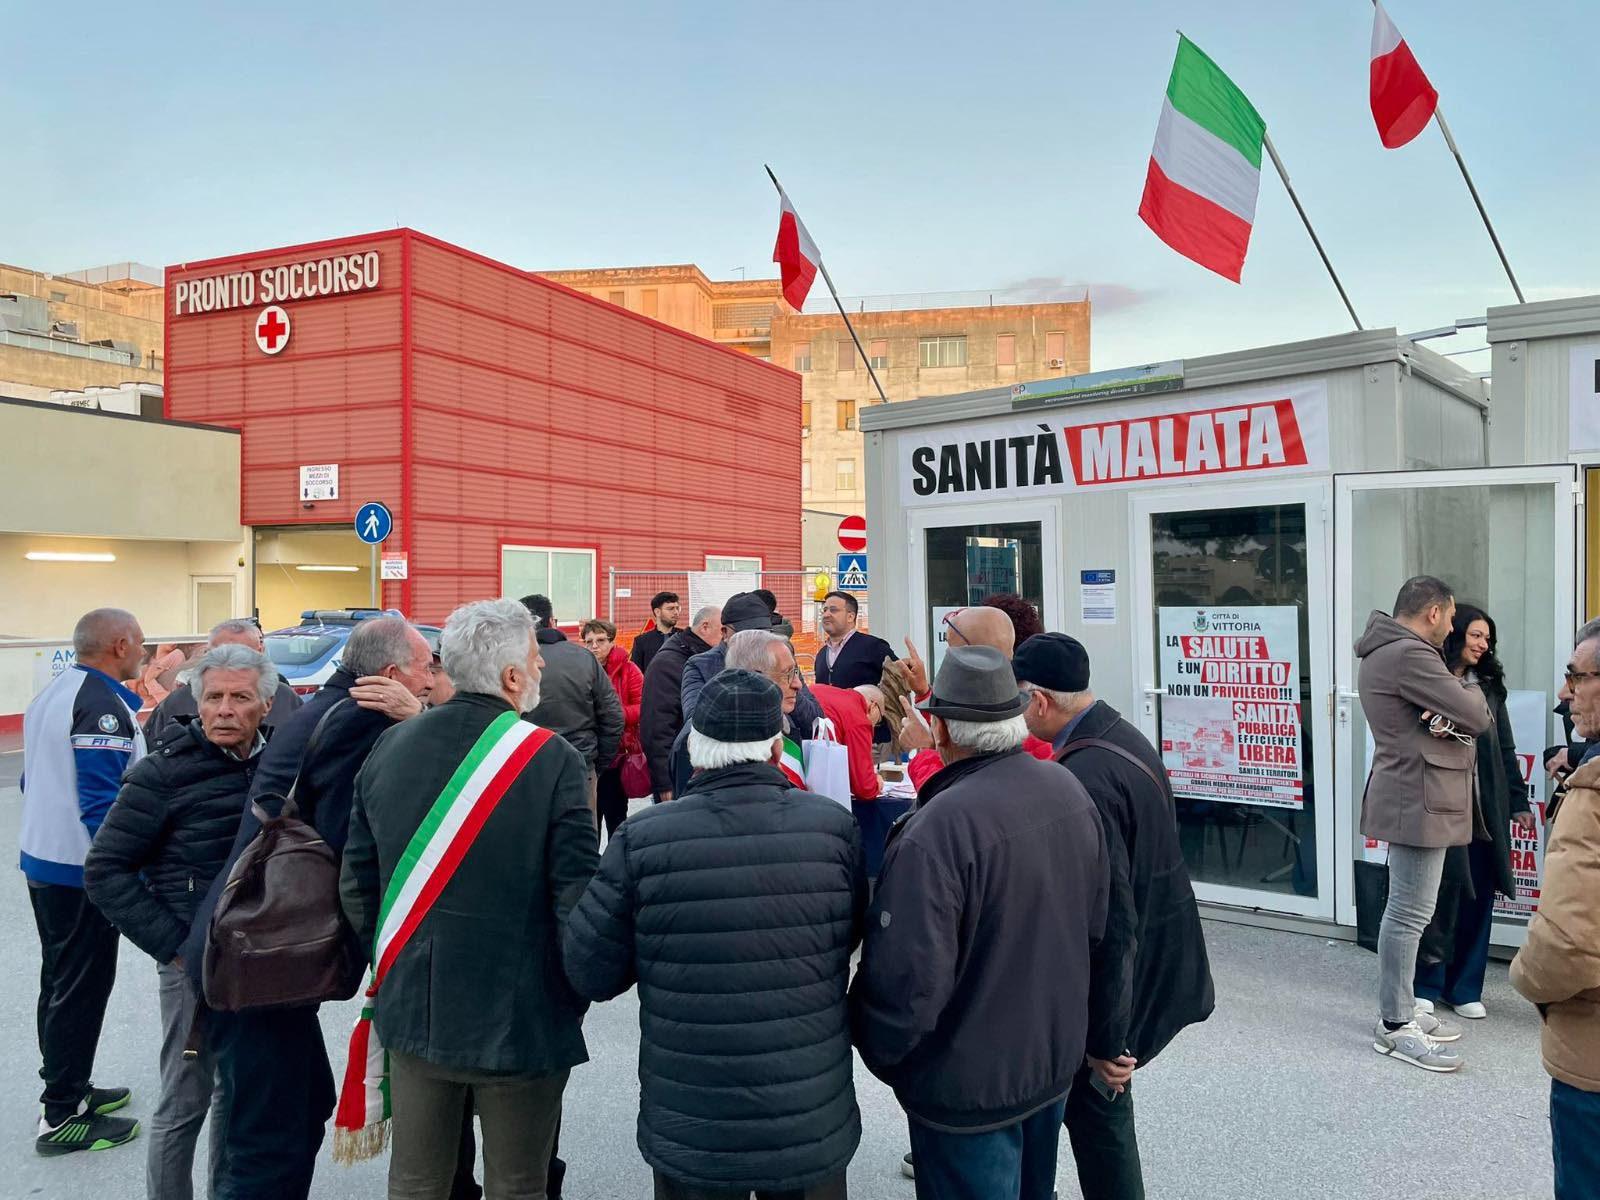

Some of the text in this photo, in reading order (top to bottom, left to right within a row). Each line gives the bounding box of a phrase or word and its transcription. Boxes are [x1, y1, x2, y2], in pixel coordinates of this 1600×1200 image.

[175, 251, 379, 315] PRONTO SOCCORSO
[911, 404, 1286, 496] SANITÀ MALATA
[1212, 622, 1261, 631] VITTORIA
[1166, 635, 1260, 659] LA SALUTE
[52, 650, 75, 662] AM
[1177, 660, 1286, 684] È UN DIRITTO
[1168, 684, 1293, 700] NON UN PRIVILEGIO!!!
[1234, 702, 1297, 724] SANITÀ
[1238, 722, 1297, 737] PUBBLICA
[1238, 734, 1297, 747] EFFICIENTE
[1238, 743, 1297, 764] LIBERA
[1238, 767, 1298, 779] SANITÀ E TERRITORI
[1190, 779, 1212, 787] GUARDIE
